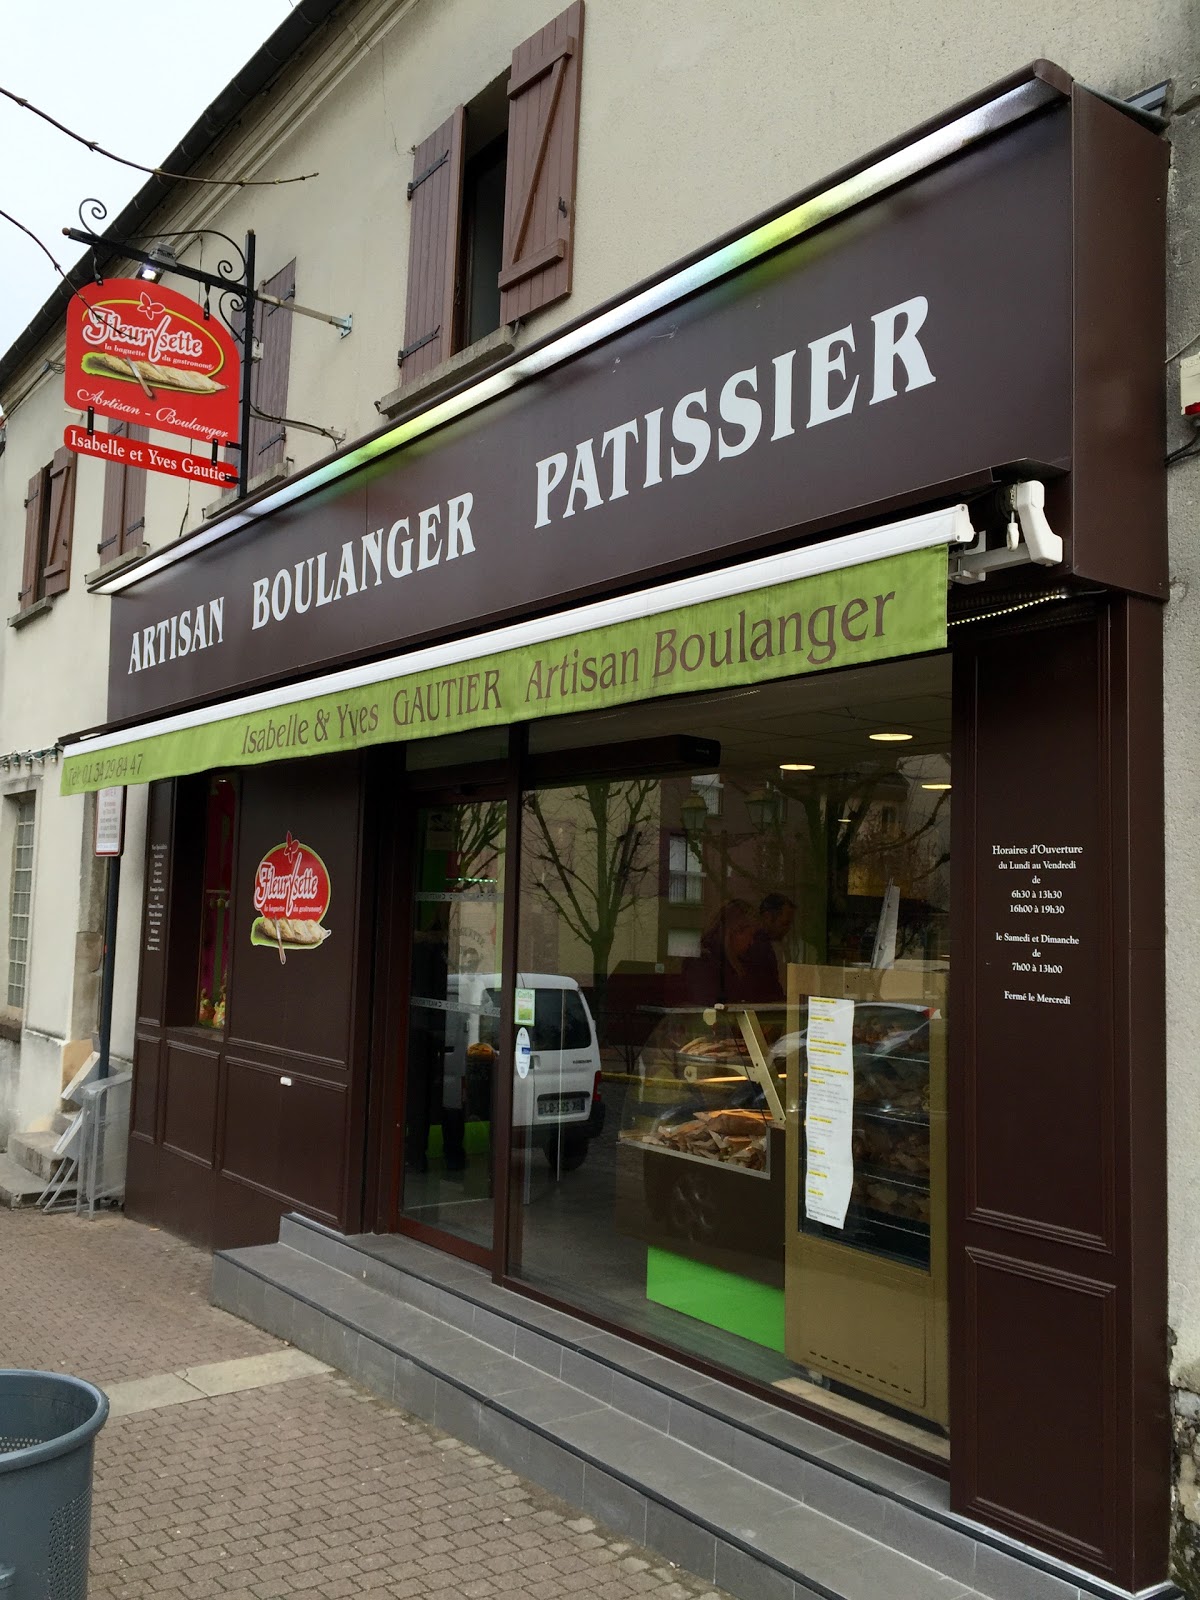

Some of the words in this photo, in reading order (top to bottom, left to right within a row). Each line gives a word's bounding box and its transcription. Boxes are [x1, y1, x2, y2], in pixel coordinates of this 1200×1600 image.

[104, 342, 112, 351] la
[114, 344, 146, 357] baguette
[162, 354, 171, 362] du
[76, 388, 141, 415] Artisan
[155, 407, 229, 440] Boulanger
[70, 429, 125, 457] Isabelle
[129, 450, 143, 462] et
[148, 448, 177, 470] Yves
[127, 596, 225, 675] ARTISAN
[251, 492, 476, 630] BOULANGER
[534, 295, 937, 529] PATISSIER
[116, 756, 128, 778] 84
[130, 753, 143, 775] 47
[241, 713, 309, 755] Isabelle
[313, 708, 331, 742] &
[336, 703, 379, 739] Yves
[393, 669, 502, 726] GAUTIER
[525, 647, 639, 702] Artisan
[652, 590, 896, 678] Boulanger
[992, 845, 1028, 855] Horaires
[1029, 844, 1083, 855] d'Ouverture
[998, 861, 1007, 869] du
[1009, 861, 1030, 869] Lundi
[1043, 861, 1076, 869] Vendredi
[1031, 875, 1041, 884] de
[1011, 890, 1030, 899] 6h30
[1032, 890, 1037, 899] à
[1038, 890, 1062, 899] 13h30
[1010, 904, 1033, 914] 16h00
[1034, 904, 1039, 913] à
[1041, 905, 1065, 914] 19h30
[995, 932, 1003, 941] le
[1004, 932, 1030, 943] Samedi
[1032, 935, 1039, 943] et
[1041, 934, 1080, 945] Dimanche
[1032, 949, 1041, 958] de
[1012, 962, 1030, 972] 7h00
[1032, 963, 1037, 972] à
[1039, 964, 1063, 974] 13h00
[1004, 990, 1027, 1001] Fermé
[1028, 993, 1035, 1002] le
[1037, 993, 1071, 1005] Mercredi
